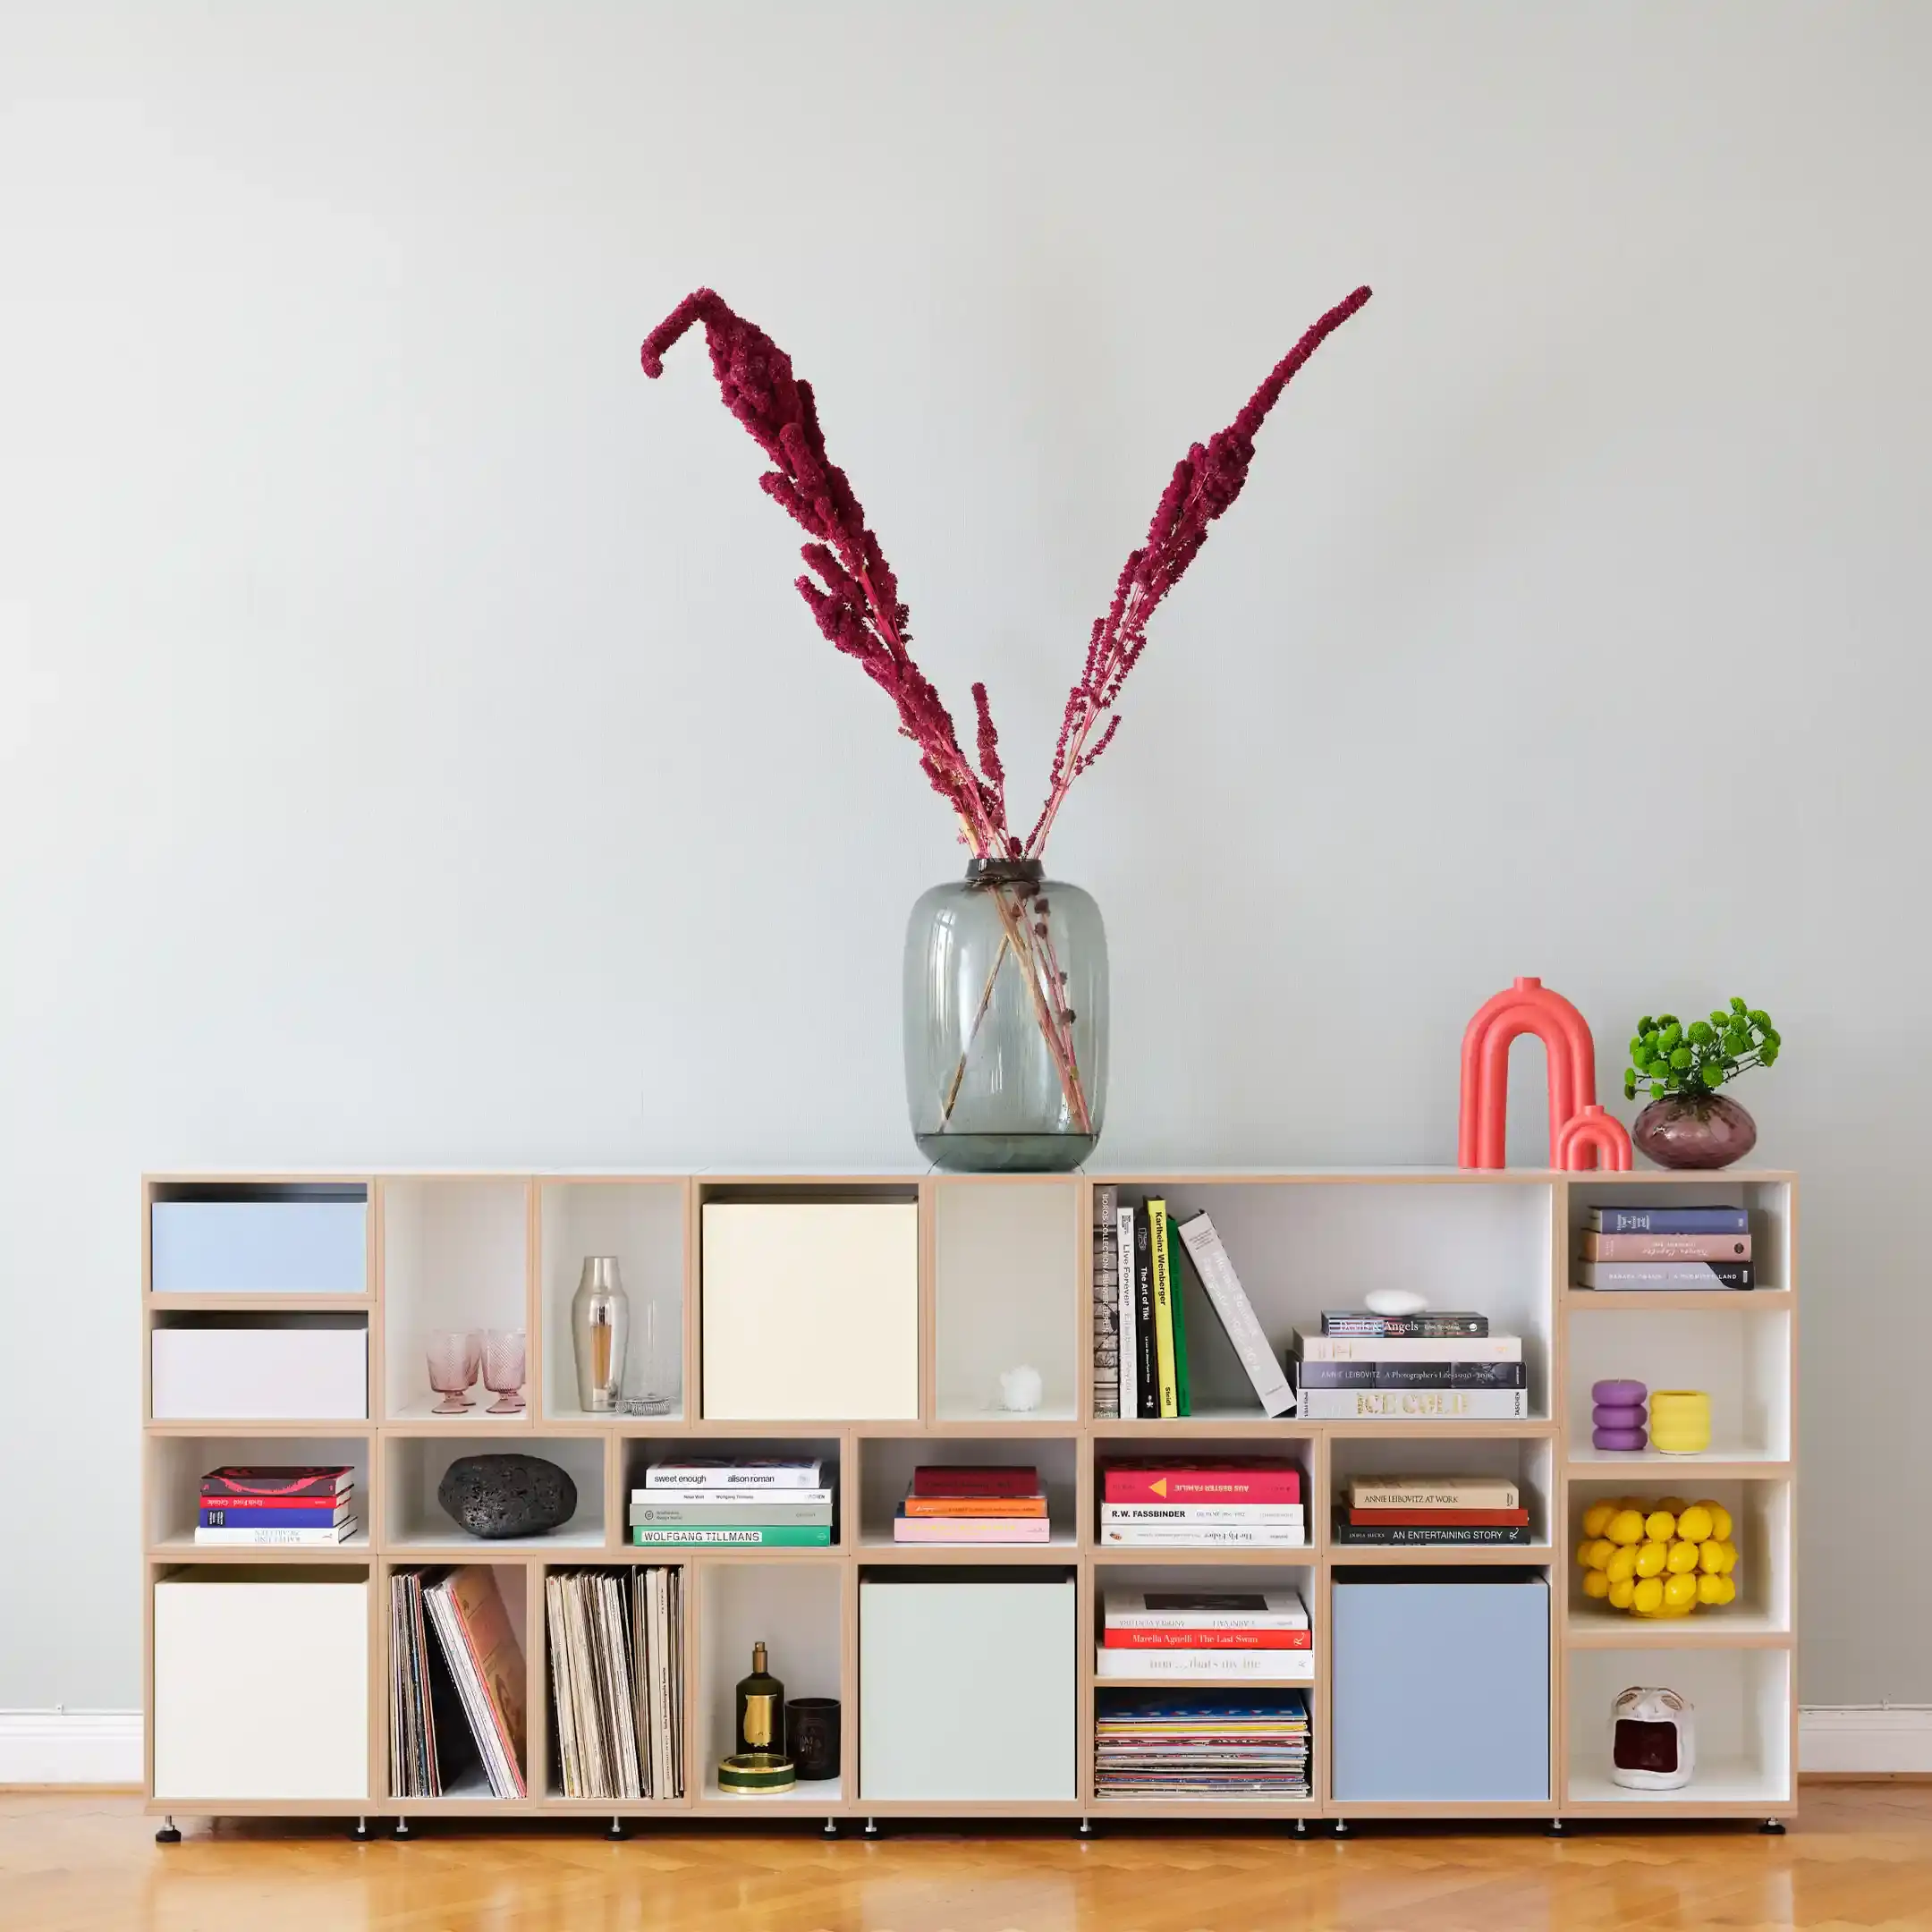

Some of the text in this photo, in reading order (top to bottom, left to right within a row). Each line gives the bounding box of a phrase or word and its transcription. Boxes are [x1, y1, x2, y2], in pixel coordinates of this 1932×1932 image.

[1123, 1244, 1131, 1266] Live
[1155, 1211, 1166, 1307] Karlheinz Weinberger
[1123, 1267, 1131, 1307] Forever
[1383, 1320, 1419, 1334] Angels
[1345, 1370, 1381, 1379] LEIBOVITZ
[1357, 1393, 1468, 1415] ICE COLD
[654, 1474, 775, 1485] sweet enough alison roman
[1388, 1496, 1424, 1504] LEIBOVITZ
[1425, 1496, 1435, 1504] AT
[1435, 1496, 1459, 1504] WORK
[1112, 1510, 1131, 1518] R.W.
[1132, 1510, 1186, 1518] FASSBINDER
[644, 1531, 759, 1542] WOLFGANG TILLMANS
[1393, 1530, 1504, 1539] AN ENTERTAINING STORY
[1132, 1634, 1162, 1643] Marella
[1163, 1634, 1192, 1646] Agnelli
[1198, 1634, 1215, 1643] The
[1216, 1634, 1233, 1643] Last
